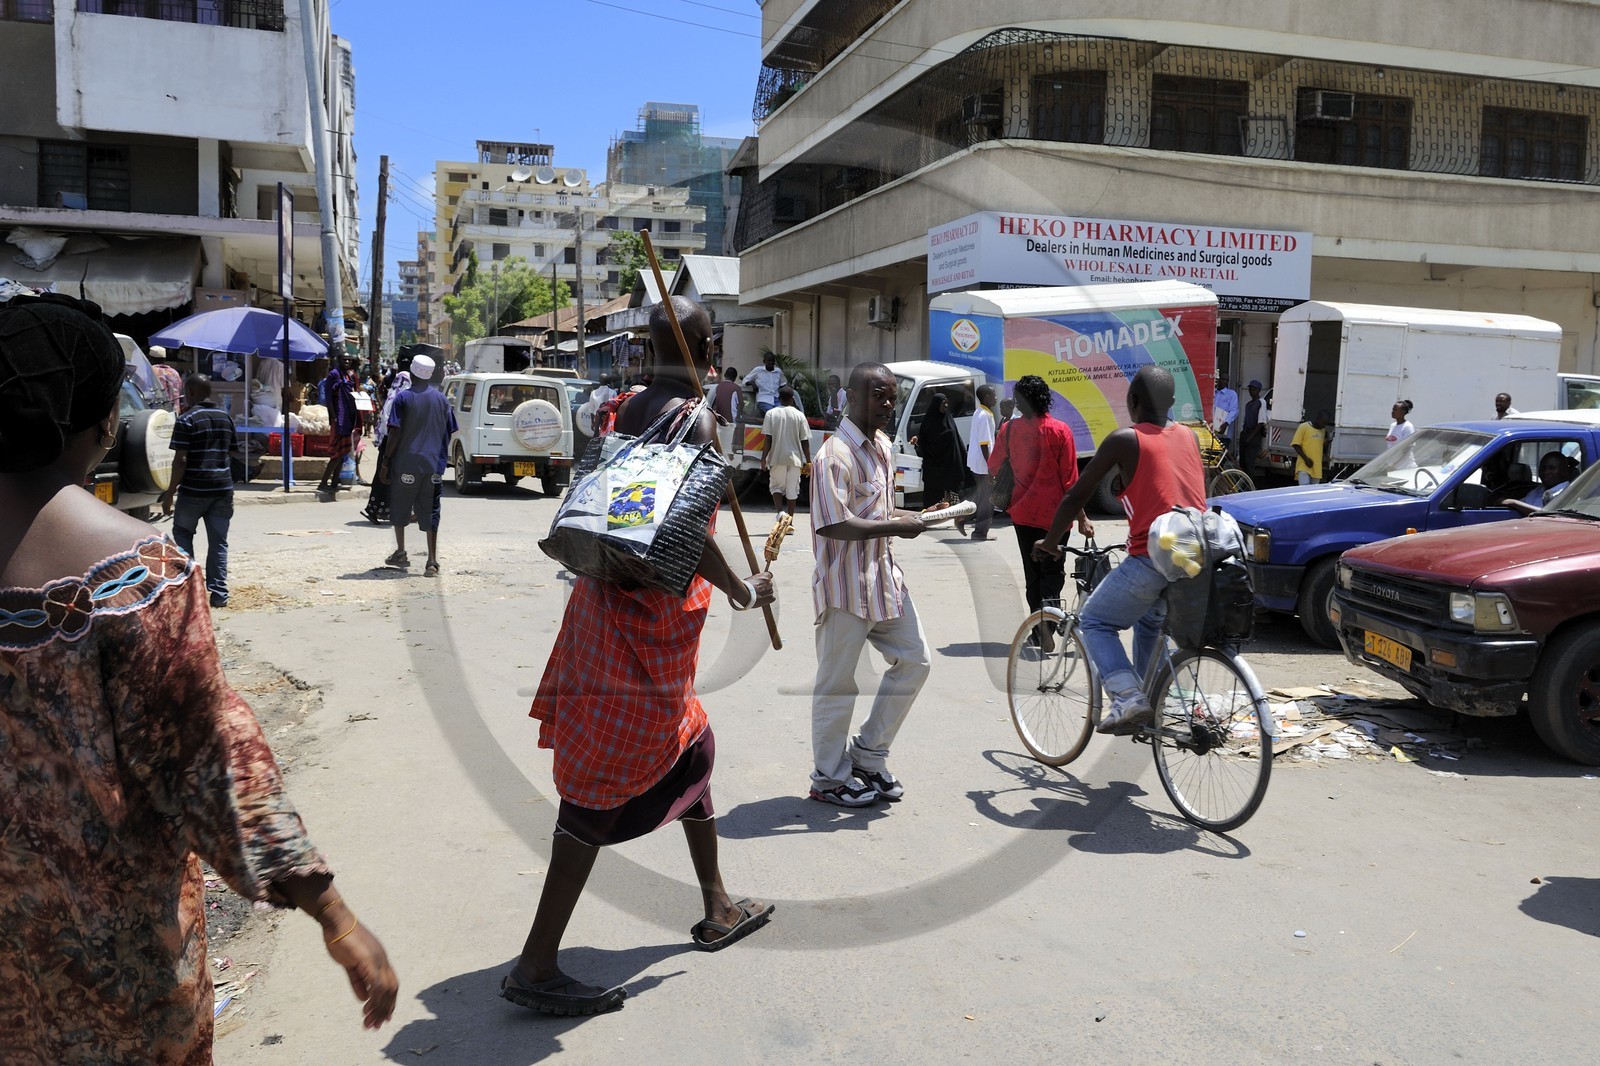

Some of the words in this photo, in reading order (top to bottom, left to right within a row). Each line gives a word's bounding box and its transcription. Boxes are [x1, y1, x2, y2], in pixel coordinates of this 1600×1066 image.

[998, 216, 1066, 238] HEKO
[1072, 221, 1200, 246] PHARMACY
[1206, 230, 1297, 252] LIMITED
[1026, 238, 1066, 254] Dealers
[1070, 241, 1079, 254] in
[1082, 242, 1120, 258] Human
[1123, 246, 1175, 261] Medicines
[1177, 249, 1196, 262] and
[1200, 250, 1239, 267] Surgical
[1242, 253, 1272, 268] goods
[1064, 259, 1152, 276] WHOLESALE
[1157, 265, 1186, 277] AND
[1190, 267, 1238, 280] RETAIL
[1090, 274, 1112, 282] Email:
[1054, 315, 1184, 362] HOMADEX
[1048, 367, 1077, 376] KITULIZO
[1093, 364, 1122, 372] MAUMIVU
[616, 510, 643, 522] KAKA
[1372, 584, 1400, 600] TOYOTA
